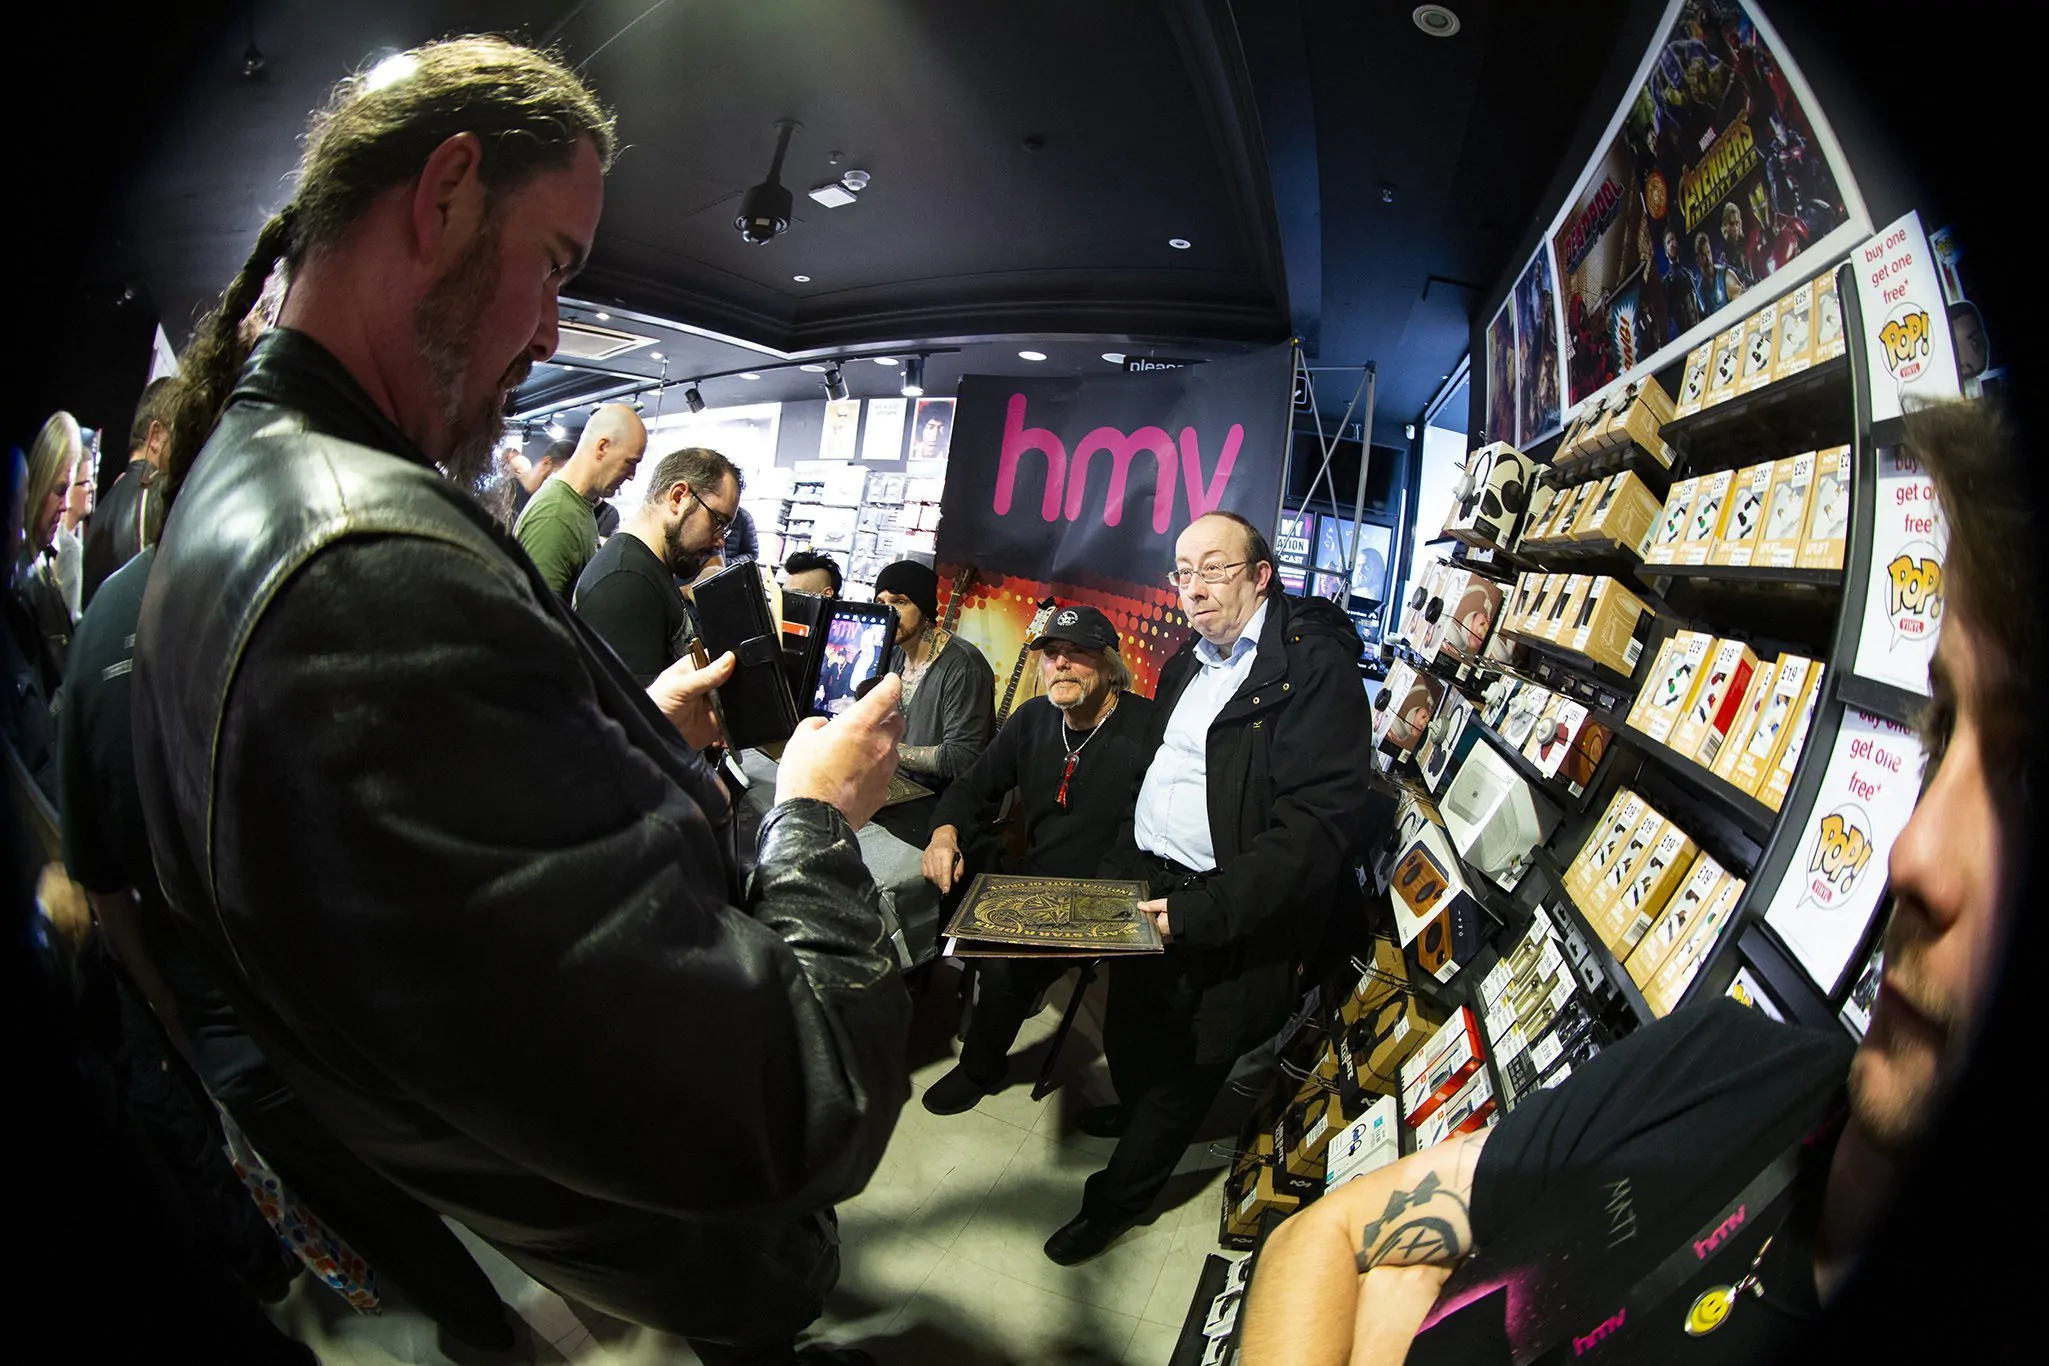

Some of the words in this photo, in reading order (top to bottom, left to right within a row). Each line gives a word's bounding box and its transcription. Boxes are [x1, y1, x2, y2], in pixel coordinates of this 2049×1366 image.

[1865, 243, 1884, 263] buy
[1886, 228, 1907, 248] one
[1871, 264, 1890, 288] get
[1891, 252, 1913, 274] one
[1879, 311, 1930, 372] POP!
[1130, 359, 1184, 372] plea
[993, 393, 1245, 535] hmv
[1896, 483, 1918, 505] get
[1900, 619, 1924, 632] VINYL
[1850, 739, 1874, 759] get
[1875, 748, 1902, 773] one
[1809, 814, 1873, 894] POP!
[1693, 1203, 1746, 1259] hmv
[1572, 1307, 1627, 1357] hmv
